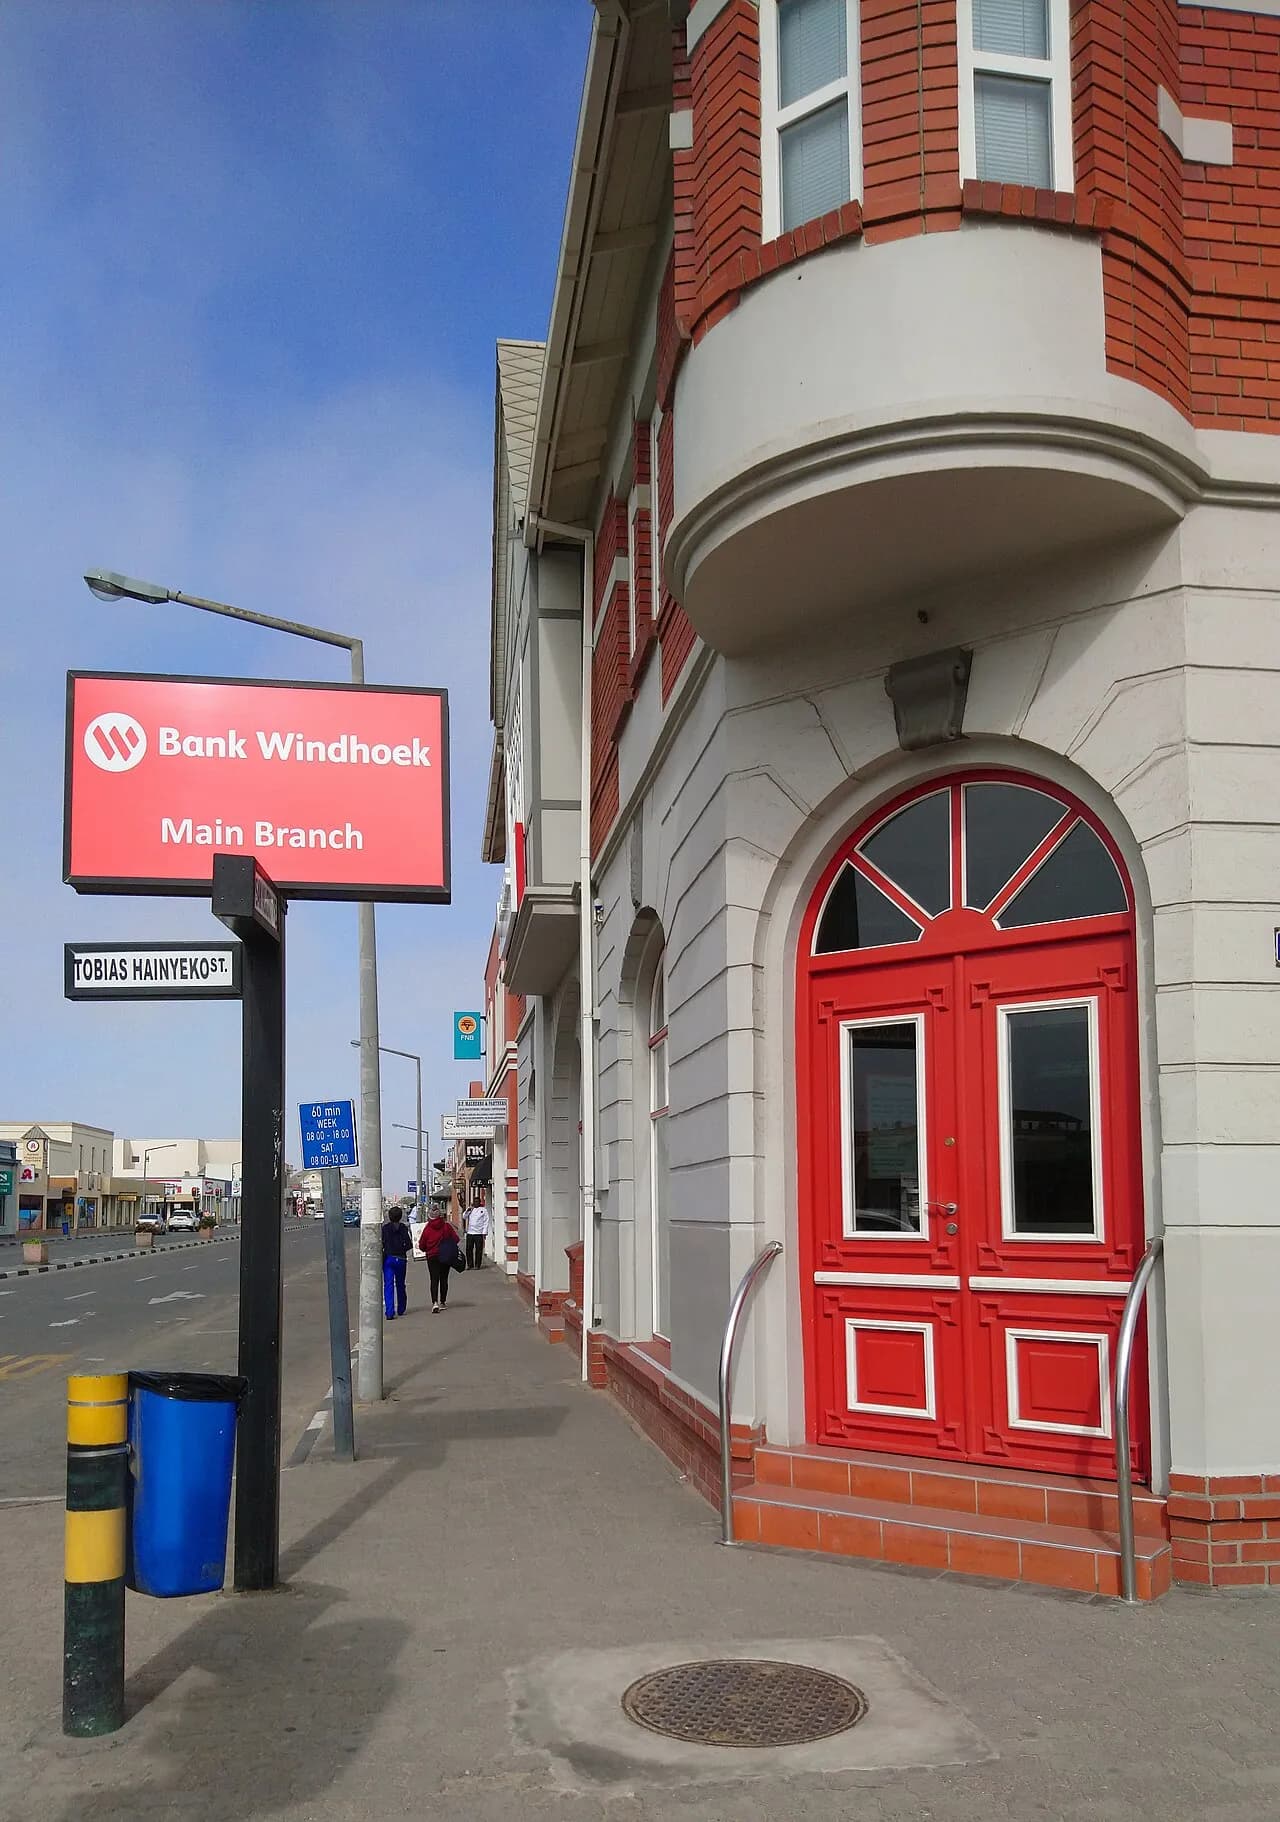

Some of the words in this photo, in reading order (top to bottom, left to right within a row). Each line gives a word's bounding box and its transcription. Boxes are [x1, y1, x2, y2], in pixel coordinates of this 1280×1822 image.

[158, 726, 248, 760] Bank
[256, 731, 432, 767] Windhoek
[160, 817, 244, 846] Main
[255, 820, 364, 850] Branch
[74, 957, 128, 981] TOBIAS
[132, 957, 209, 981] HAINYEKO
[311, 1105, 322, 1118] 60
[324, 1104, 341, 1117] min
[316, 1118, 338, 1129] WEEK
[320, 1142, 334, 1153] SAT
